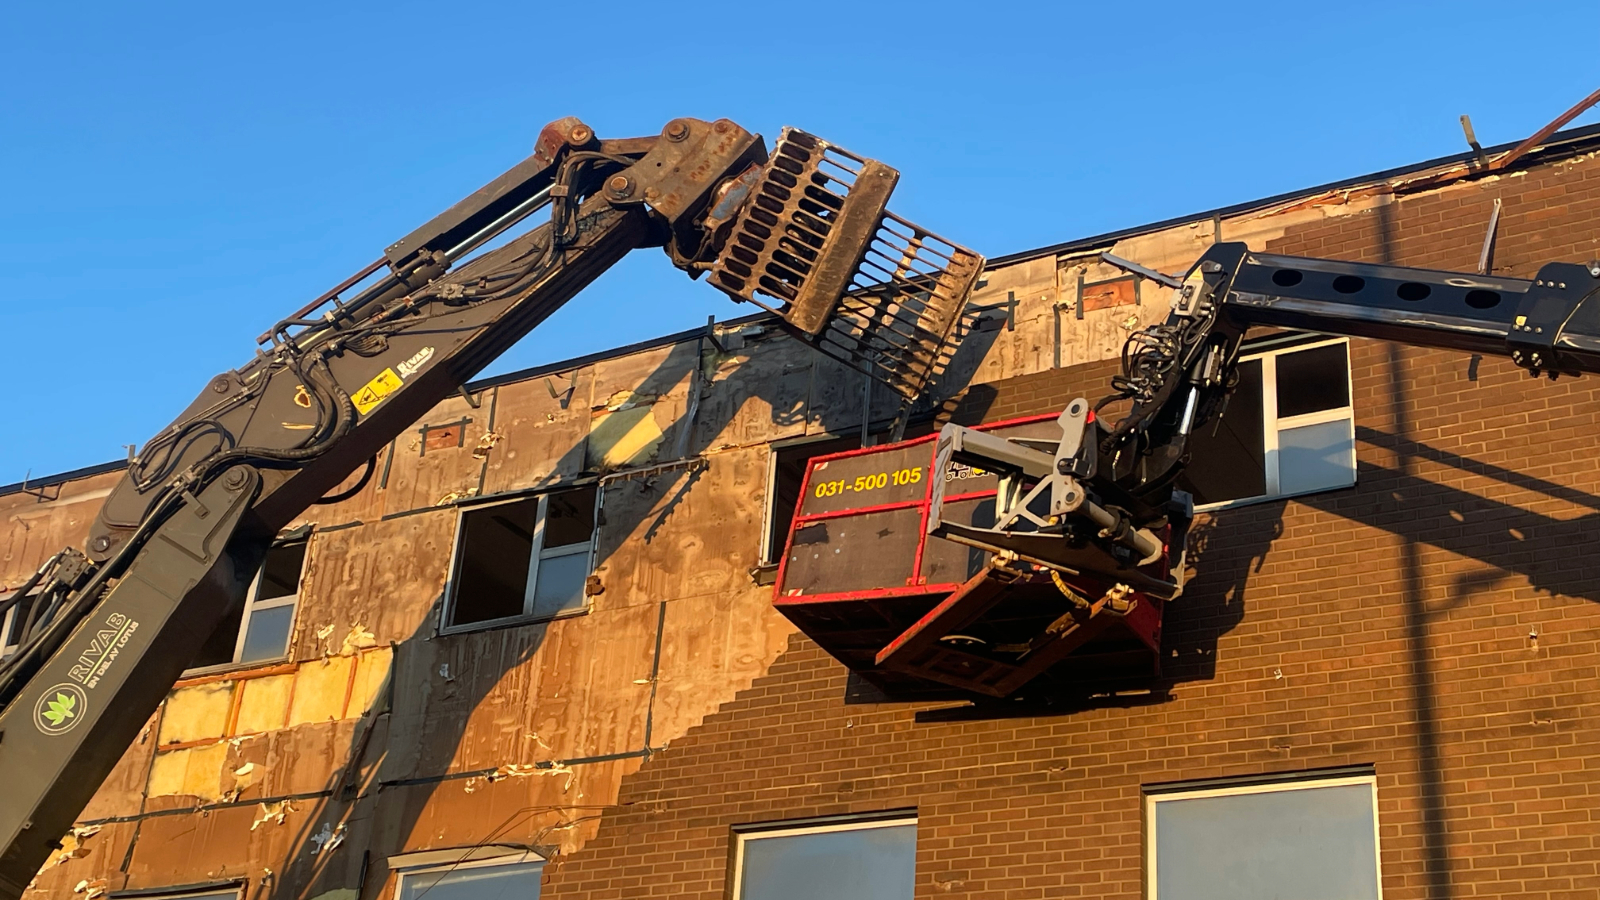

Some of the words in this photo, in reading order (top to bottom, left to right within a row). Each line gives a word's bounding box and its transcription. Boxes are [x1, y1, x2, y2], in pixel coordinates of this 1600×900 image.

[815, 473, 888, 498] 031-500
[892, 467, 922, 485] 105
[68, 612, 126, 682] RIVAB
[87, 676, 100, 689] EN
[97, 659, 113, 676] DEL
[109, 647, 119, 661] AV
[117, 621, 139, 648] LOTUS
